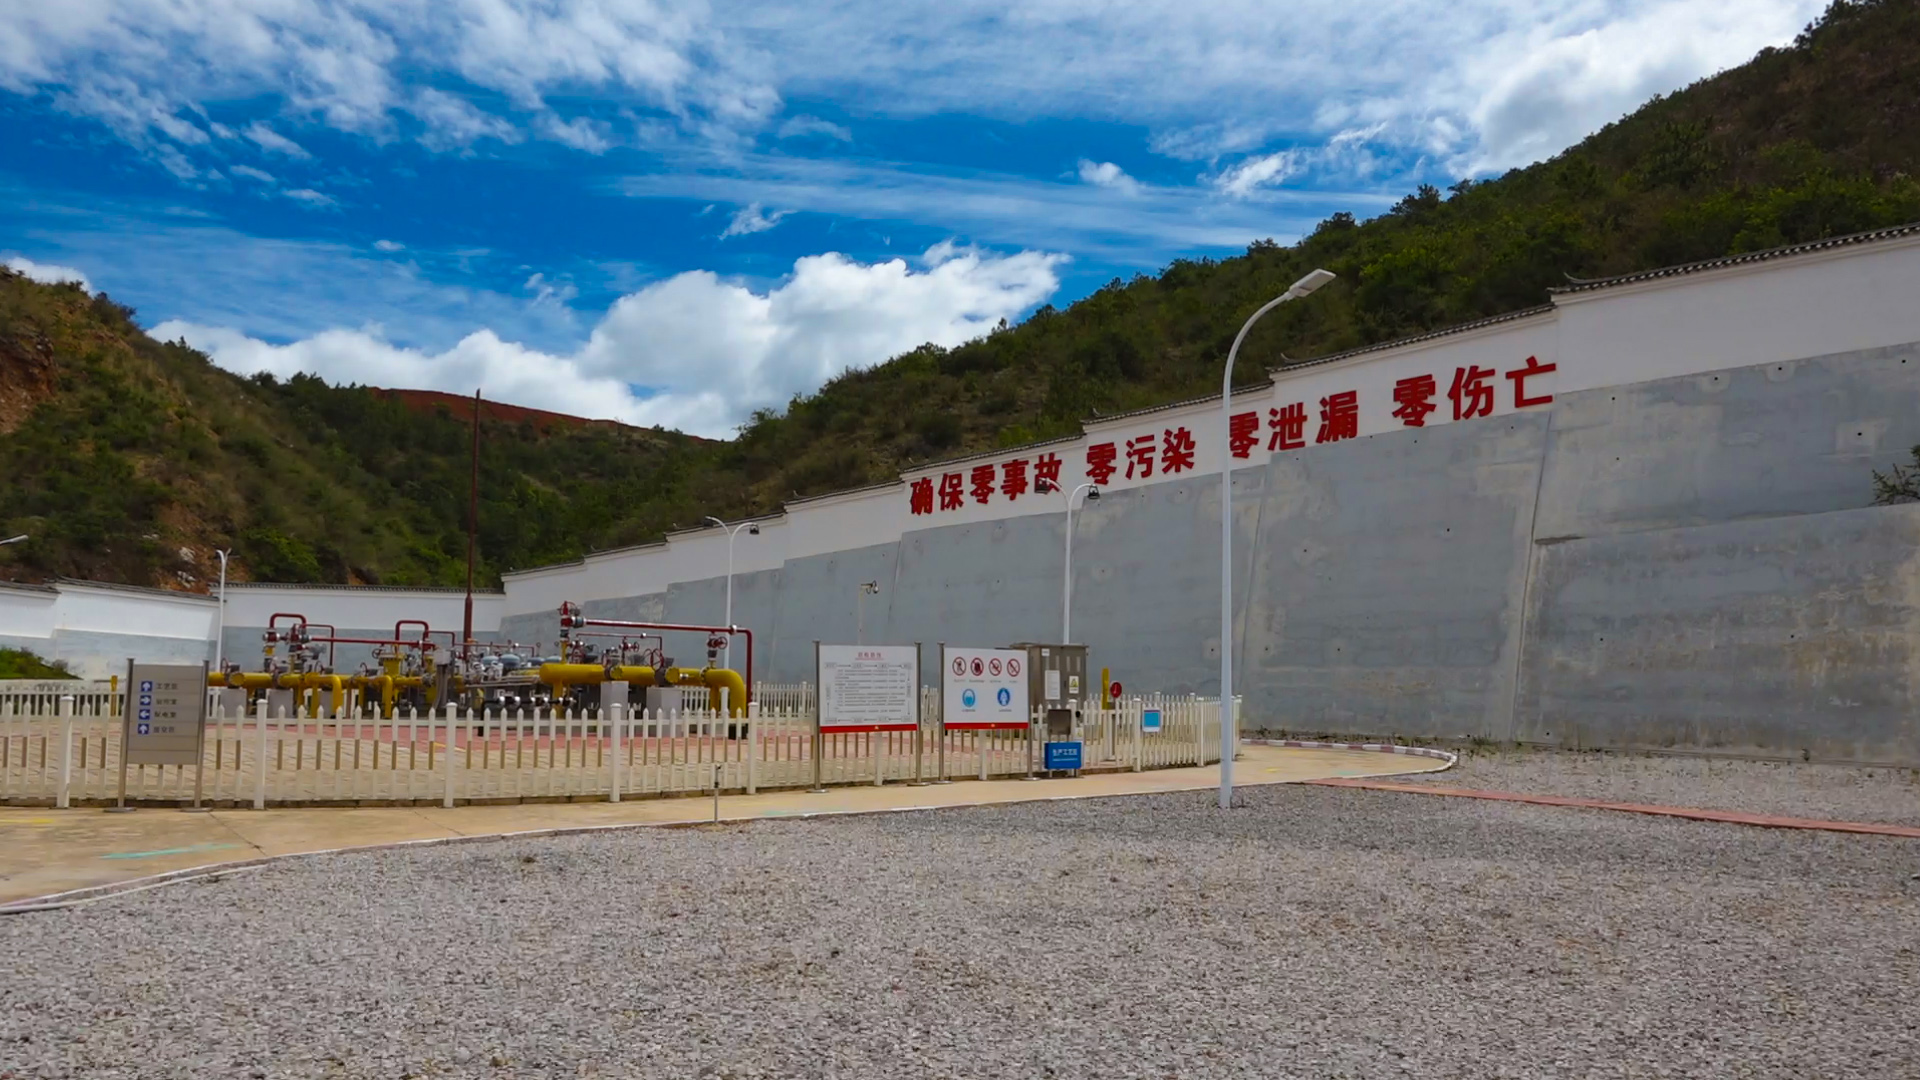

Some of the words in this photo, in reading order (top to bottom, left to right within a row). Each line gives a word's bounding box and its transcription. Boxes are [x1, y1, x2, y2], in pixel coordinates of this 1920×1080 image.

[910, 452, 1062, 515] 确保零事故
[1086, 427, 1195, 485] 零污染
[1229, 390, 1358, 459] 零泄漏
[1392, 356, 1556, 427] 零伤亡
